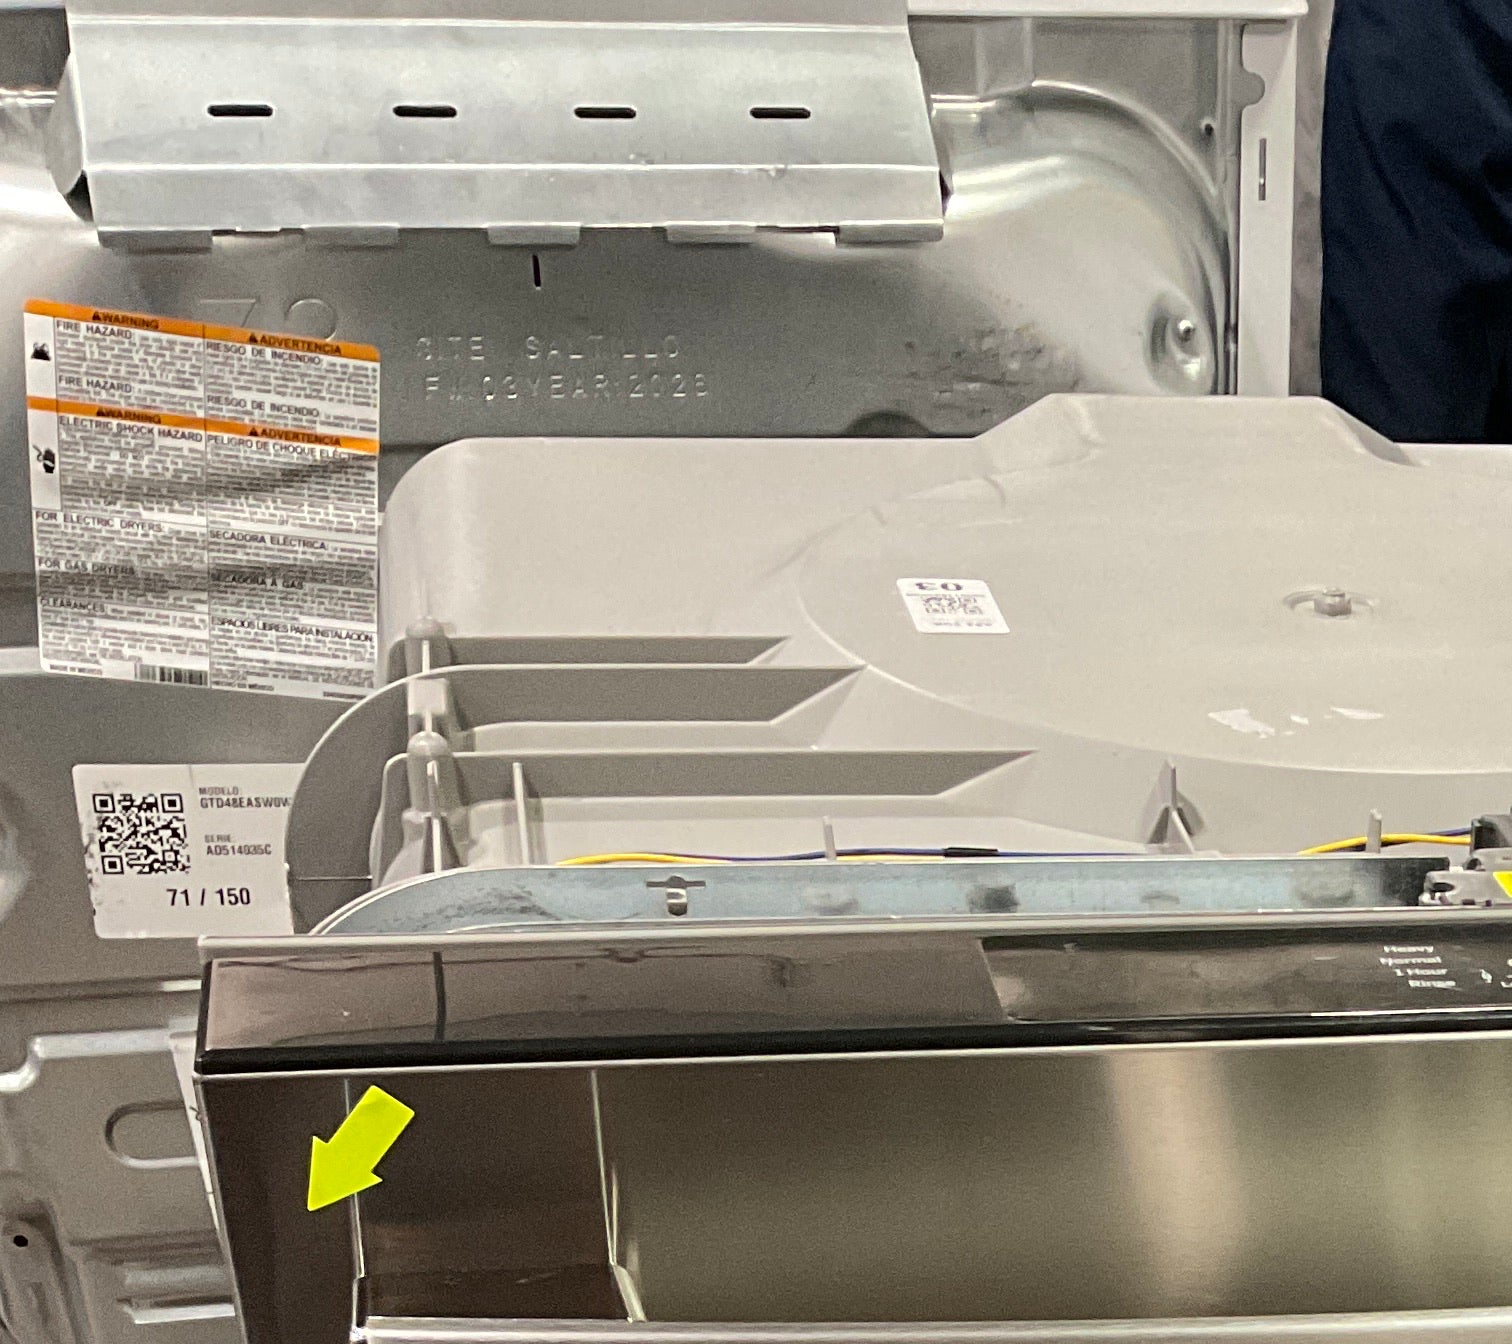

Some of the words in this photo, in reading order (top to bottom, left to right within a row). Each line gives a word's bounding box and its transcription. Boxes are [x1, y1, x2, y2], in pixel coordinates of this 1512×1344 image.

[56, 320, 80, 332] FIRE
[101, 313, 159, 329] WARNING
[206, 341, 247, 356] RIESGO
[251, 347, 265, 358] DE
[260, 335, 341, 355] ADVERTENCIA
[58, 375, 82, 387] FIRE
[206, 395, 247, 409] RIESGO
[251, 400, 265, 411] DE
[105, 408, 160, 424] WARNING
[59, 415, 113, 431] ELECTRIC
[116, 421, 153, 435] SHOCK
[157, 427, 203, 443] HAZARD
[261, 428, 341, 447] ADVERTENCIA
[207, 434, 253, 448] PELIGRO
[255, 437, 270, 449] DE
[272, 441, 320, 458] CHOQUE
[36, 510, 57, 521] FOR
[63, 512, 114, 528] ELECTRIC
[209, 529, 266, 544] SECADORA
[38, 557, 61, 570] FOR
[64, 559, 88, 573] GAS
[166, 888, 190, 906] 71
[215, 887, 251, 906] 150
[1383, 945, 1434, 954] Heavy
[1379, 956, 1442, 966] Normal
